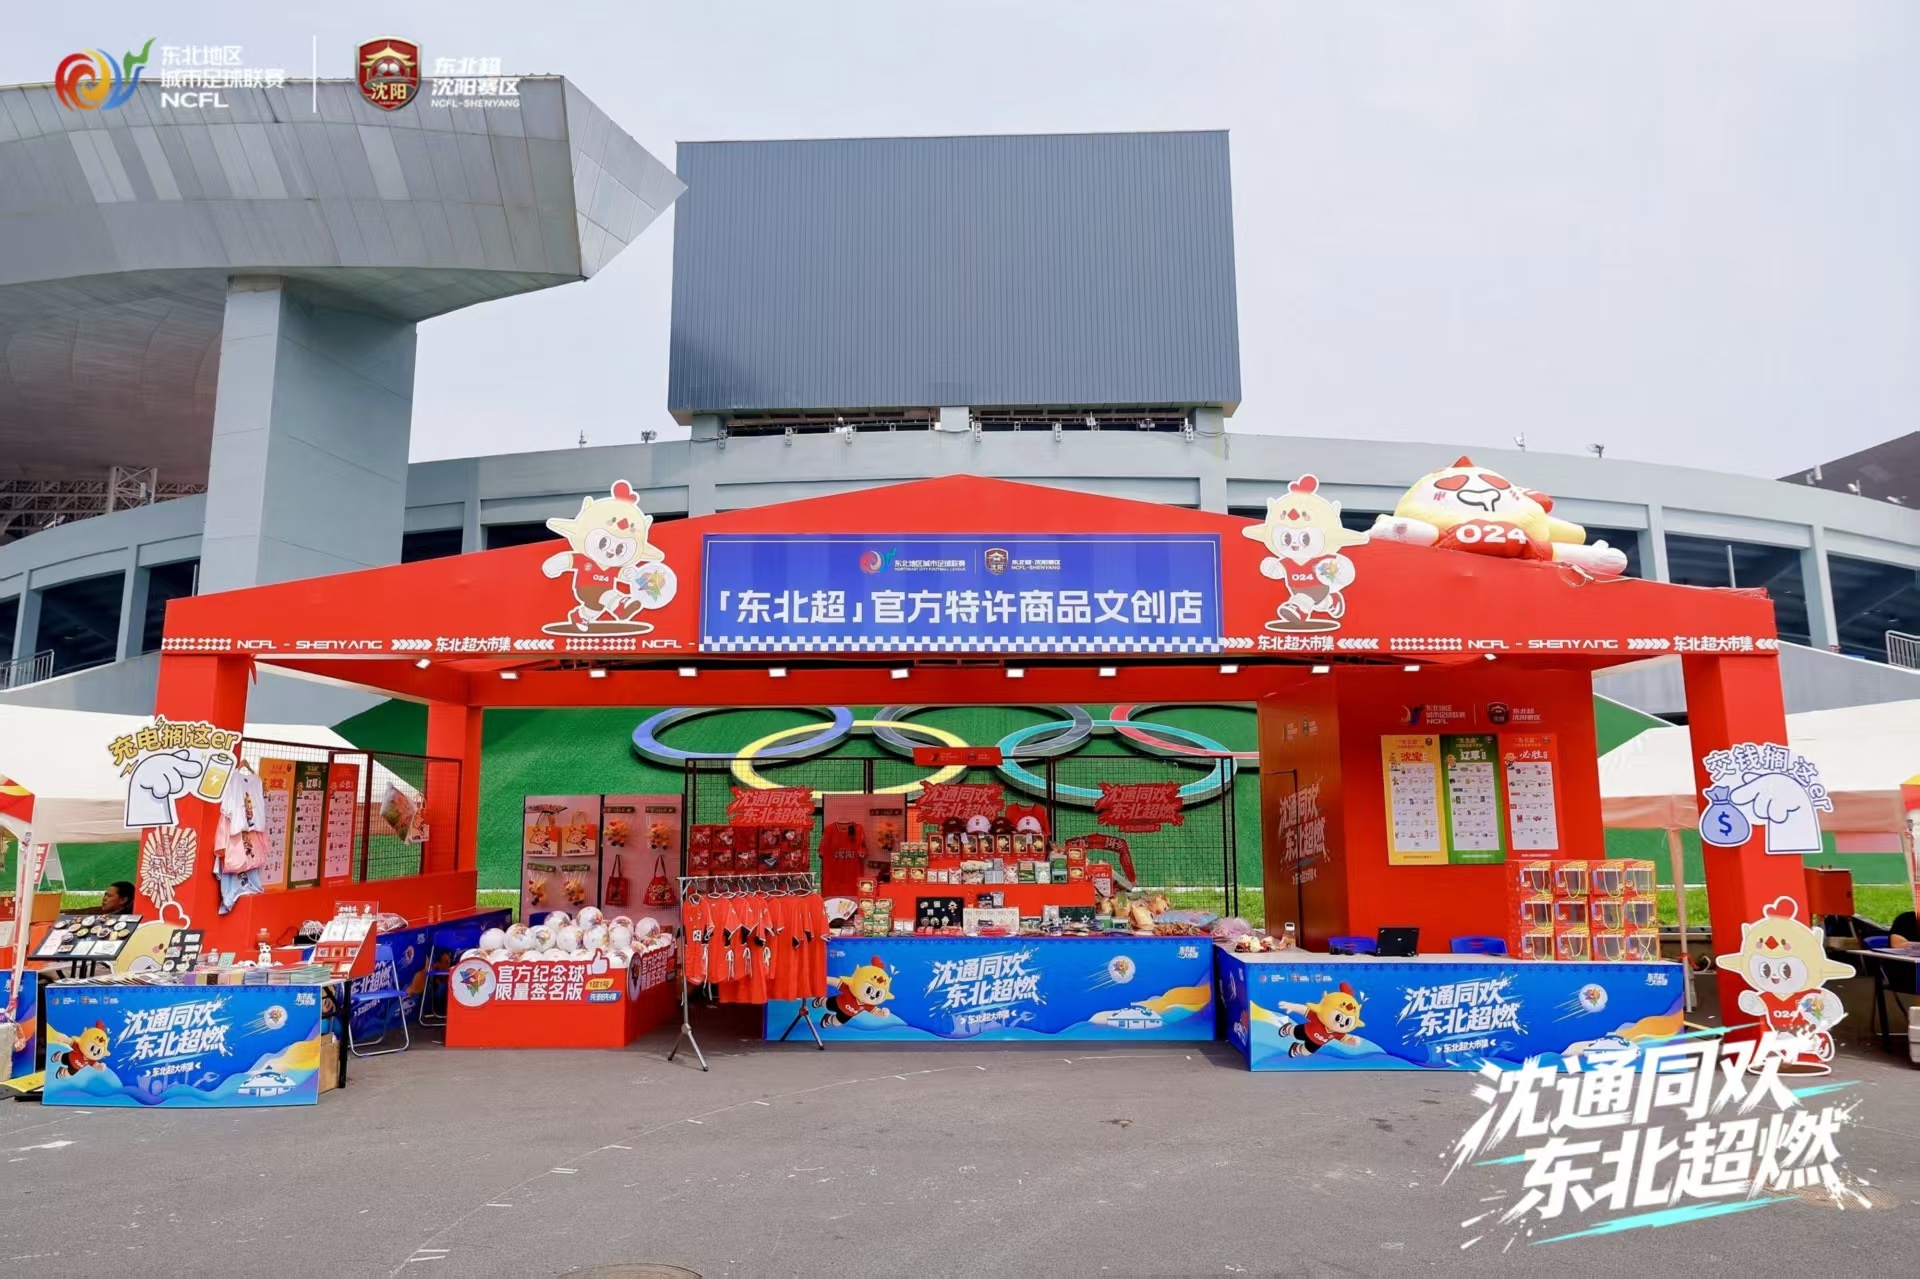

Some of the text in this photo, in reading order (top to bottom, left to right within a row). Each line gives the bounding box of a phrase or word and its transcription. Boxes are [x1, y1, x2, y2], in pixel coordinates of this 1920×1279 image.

[1456, 525, 1527, 543] 024
[719, 589, 1203, 625] 「东北超」官方特许商品文创店
[237, 640, 277, 649] NCFL
[296, 640, 382, 649] SHENYANG
[435, 637, 511, 652] 东北超大市集
[642, 640, 682, 649] NCFL
[1257, 636, 1334, 650] 东北超大市集
[1468, 640, 1510, 649] NCFL
[1528, 639, 1618, 649] SHENYANG
[1673, 636, 1753, 652] 东北超大市集
[108, 724, 239, 765] 充电搁这er
[1706, 745, 1832, 811] 交钱搁这er
[732, 790, 804, 808] 沈通同欢
[1106, 786, 1170, 803] 沈通同欢
[742, 807, 811, 824] 东北超燃
[1111, 802, 1176, 820] 东北超燃
[497, 965, 584, 983] 官方纪念球
[928, 951, 1028, 993] 沈通同欢
[495, 983, 583, 1001] 限量签名版
[944, 975, 1041, 1010] 东北超燃
[1402, 978, 1507, 1018] 沈通同欢
[120, 1000, 222, 1040] 沈通同欢
[1418, 1003, 1522, 1036] 东北超燃
[132, 1024, 230, 1060] 东北超燃
